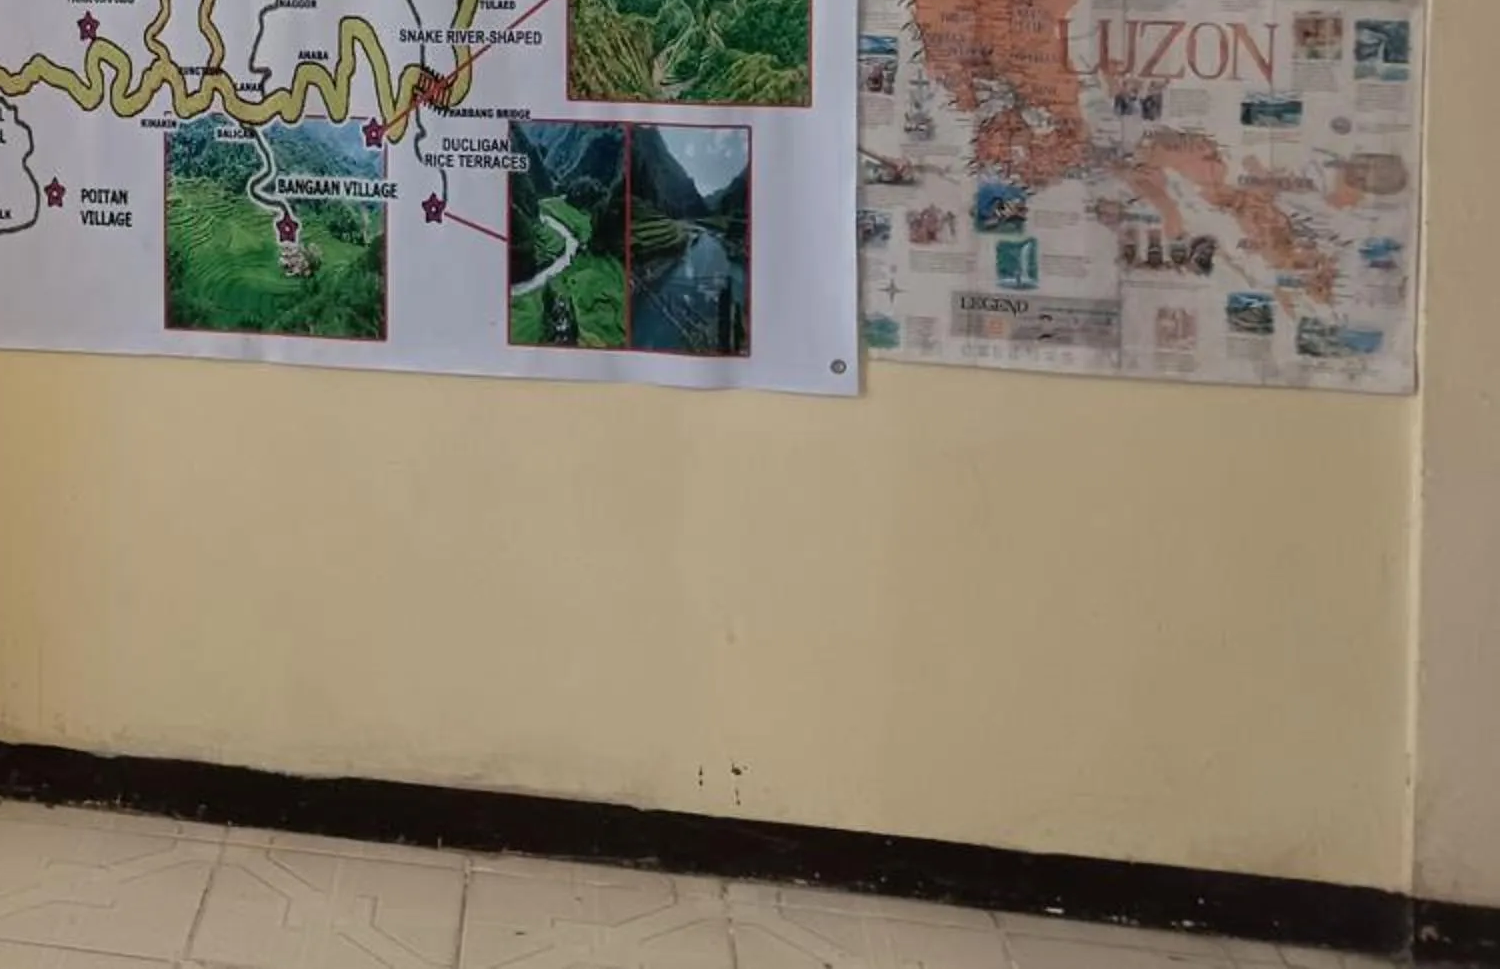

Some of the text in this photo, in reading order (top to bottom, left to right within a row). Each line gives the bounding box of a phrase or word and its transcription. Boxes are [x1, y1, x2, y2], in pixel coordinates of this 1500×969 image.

[399, 30, 543, 45] SNAKE RIVER-SHAPED
[1056, 17, 1280, 84] LUZON
[496, 109, 531, 120] BRIDGE
[442, 137, 510, 153] DUCLIGAN
[424, 153, 528, 170] RICE TERRACES
[81, 189, 128, 205] POITAN
[277, 178, 398, 199] BANGAAN VILLAGE
[81, 211, 132, 228] VILLAGE
[960, 295, 1029, 317] LEGEND
